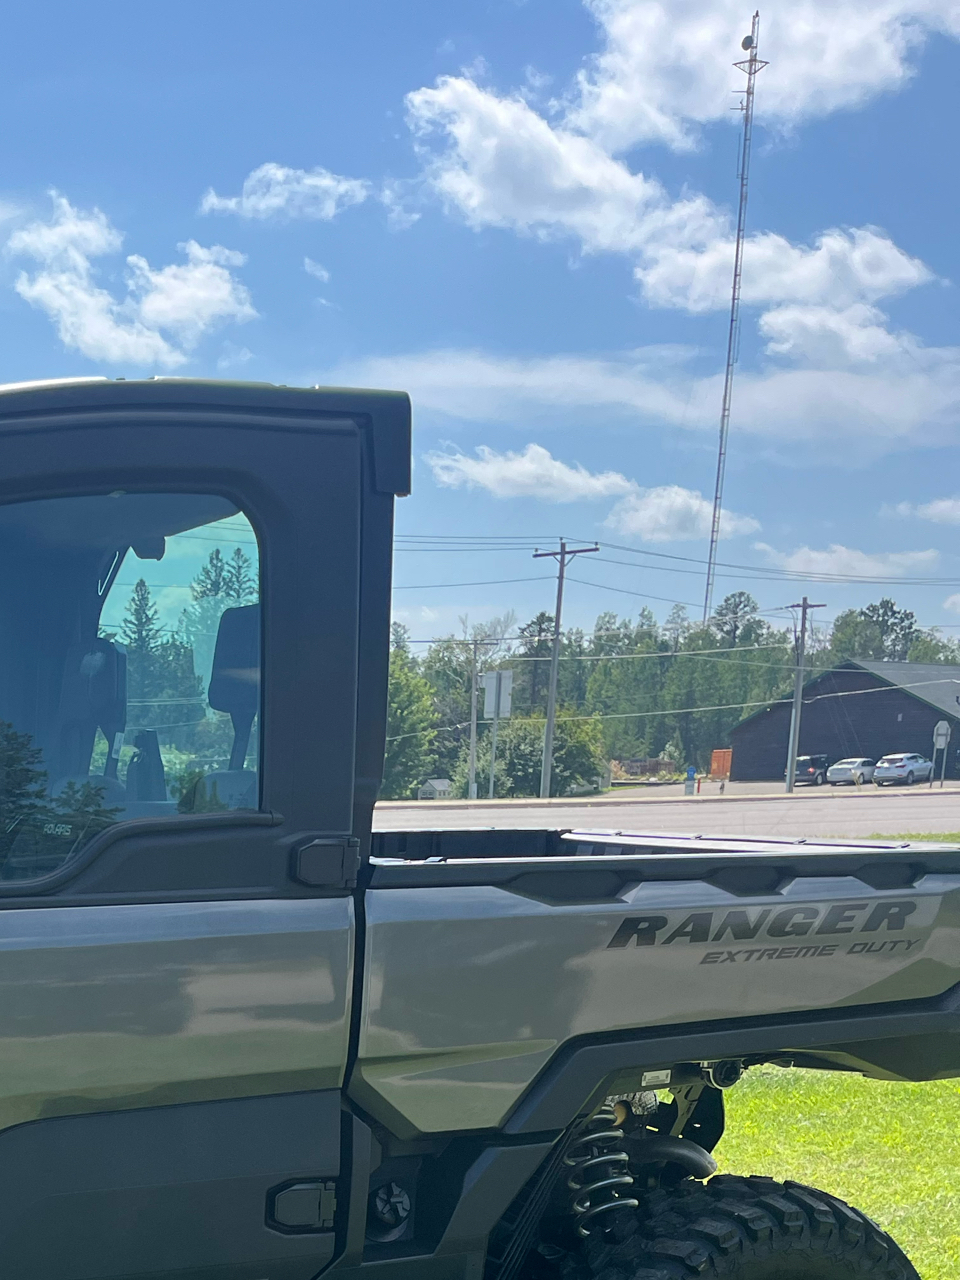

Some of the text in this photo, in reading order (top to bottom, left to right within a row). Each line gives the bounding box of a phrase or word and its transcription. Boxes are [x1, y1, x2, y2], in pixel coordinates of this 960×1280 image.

[606, 900, 917, 949] RANGER
[699, 938, 922, 965] EXTREME DUTY
